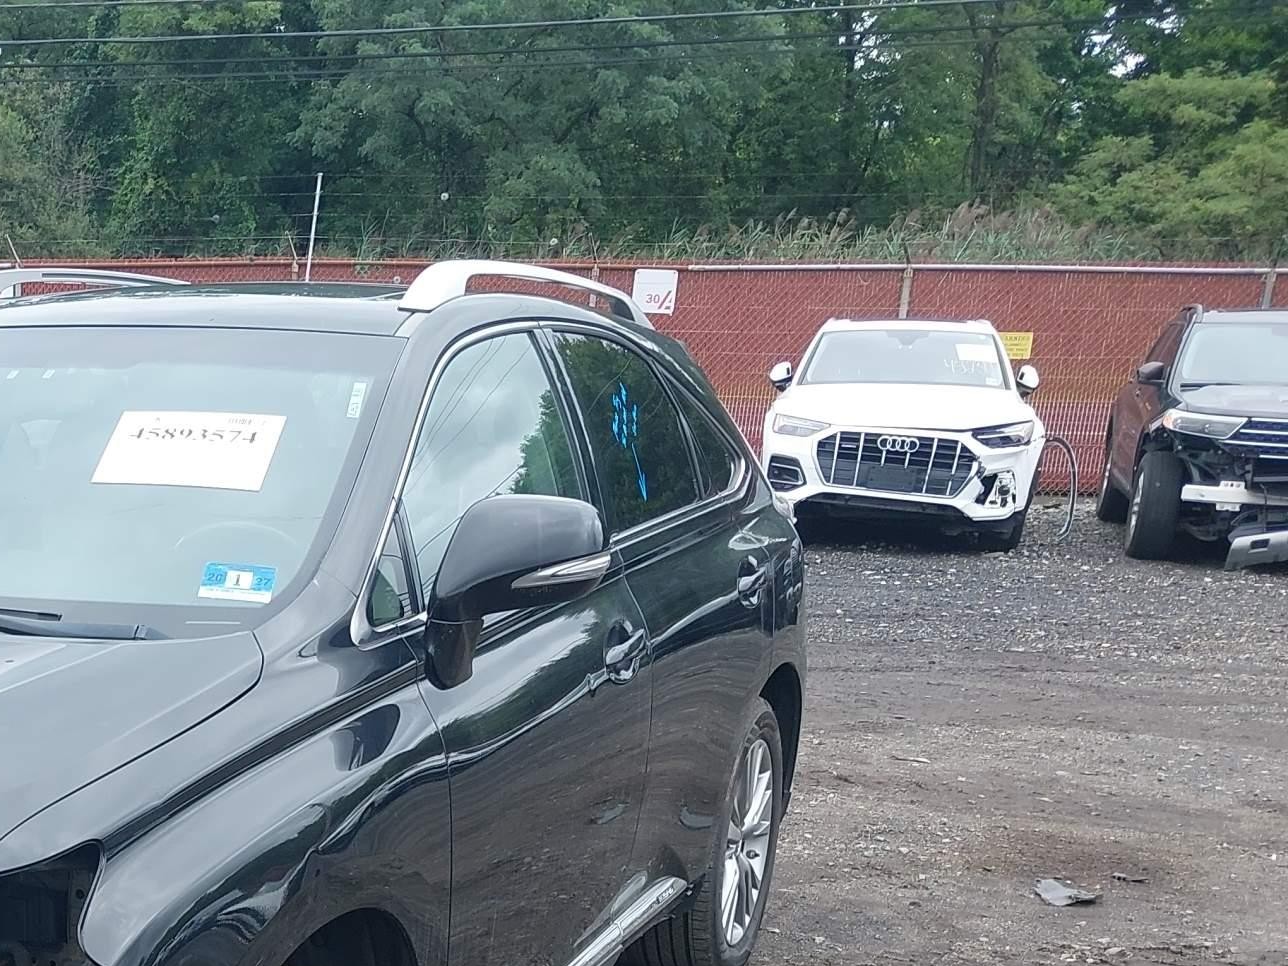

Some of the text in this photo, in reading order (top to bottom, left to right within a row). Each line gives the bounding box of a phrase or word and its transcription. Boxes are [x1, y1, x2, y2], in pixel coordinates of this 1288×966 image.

[129, 427, 258, 444] 45893574
[207, 572, 272, 587] 20 1 27
